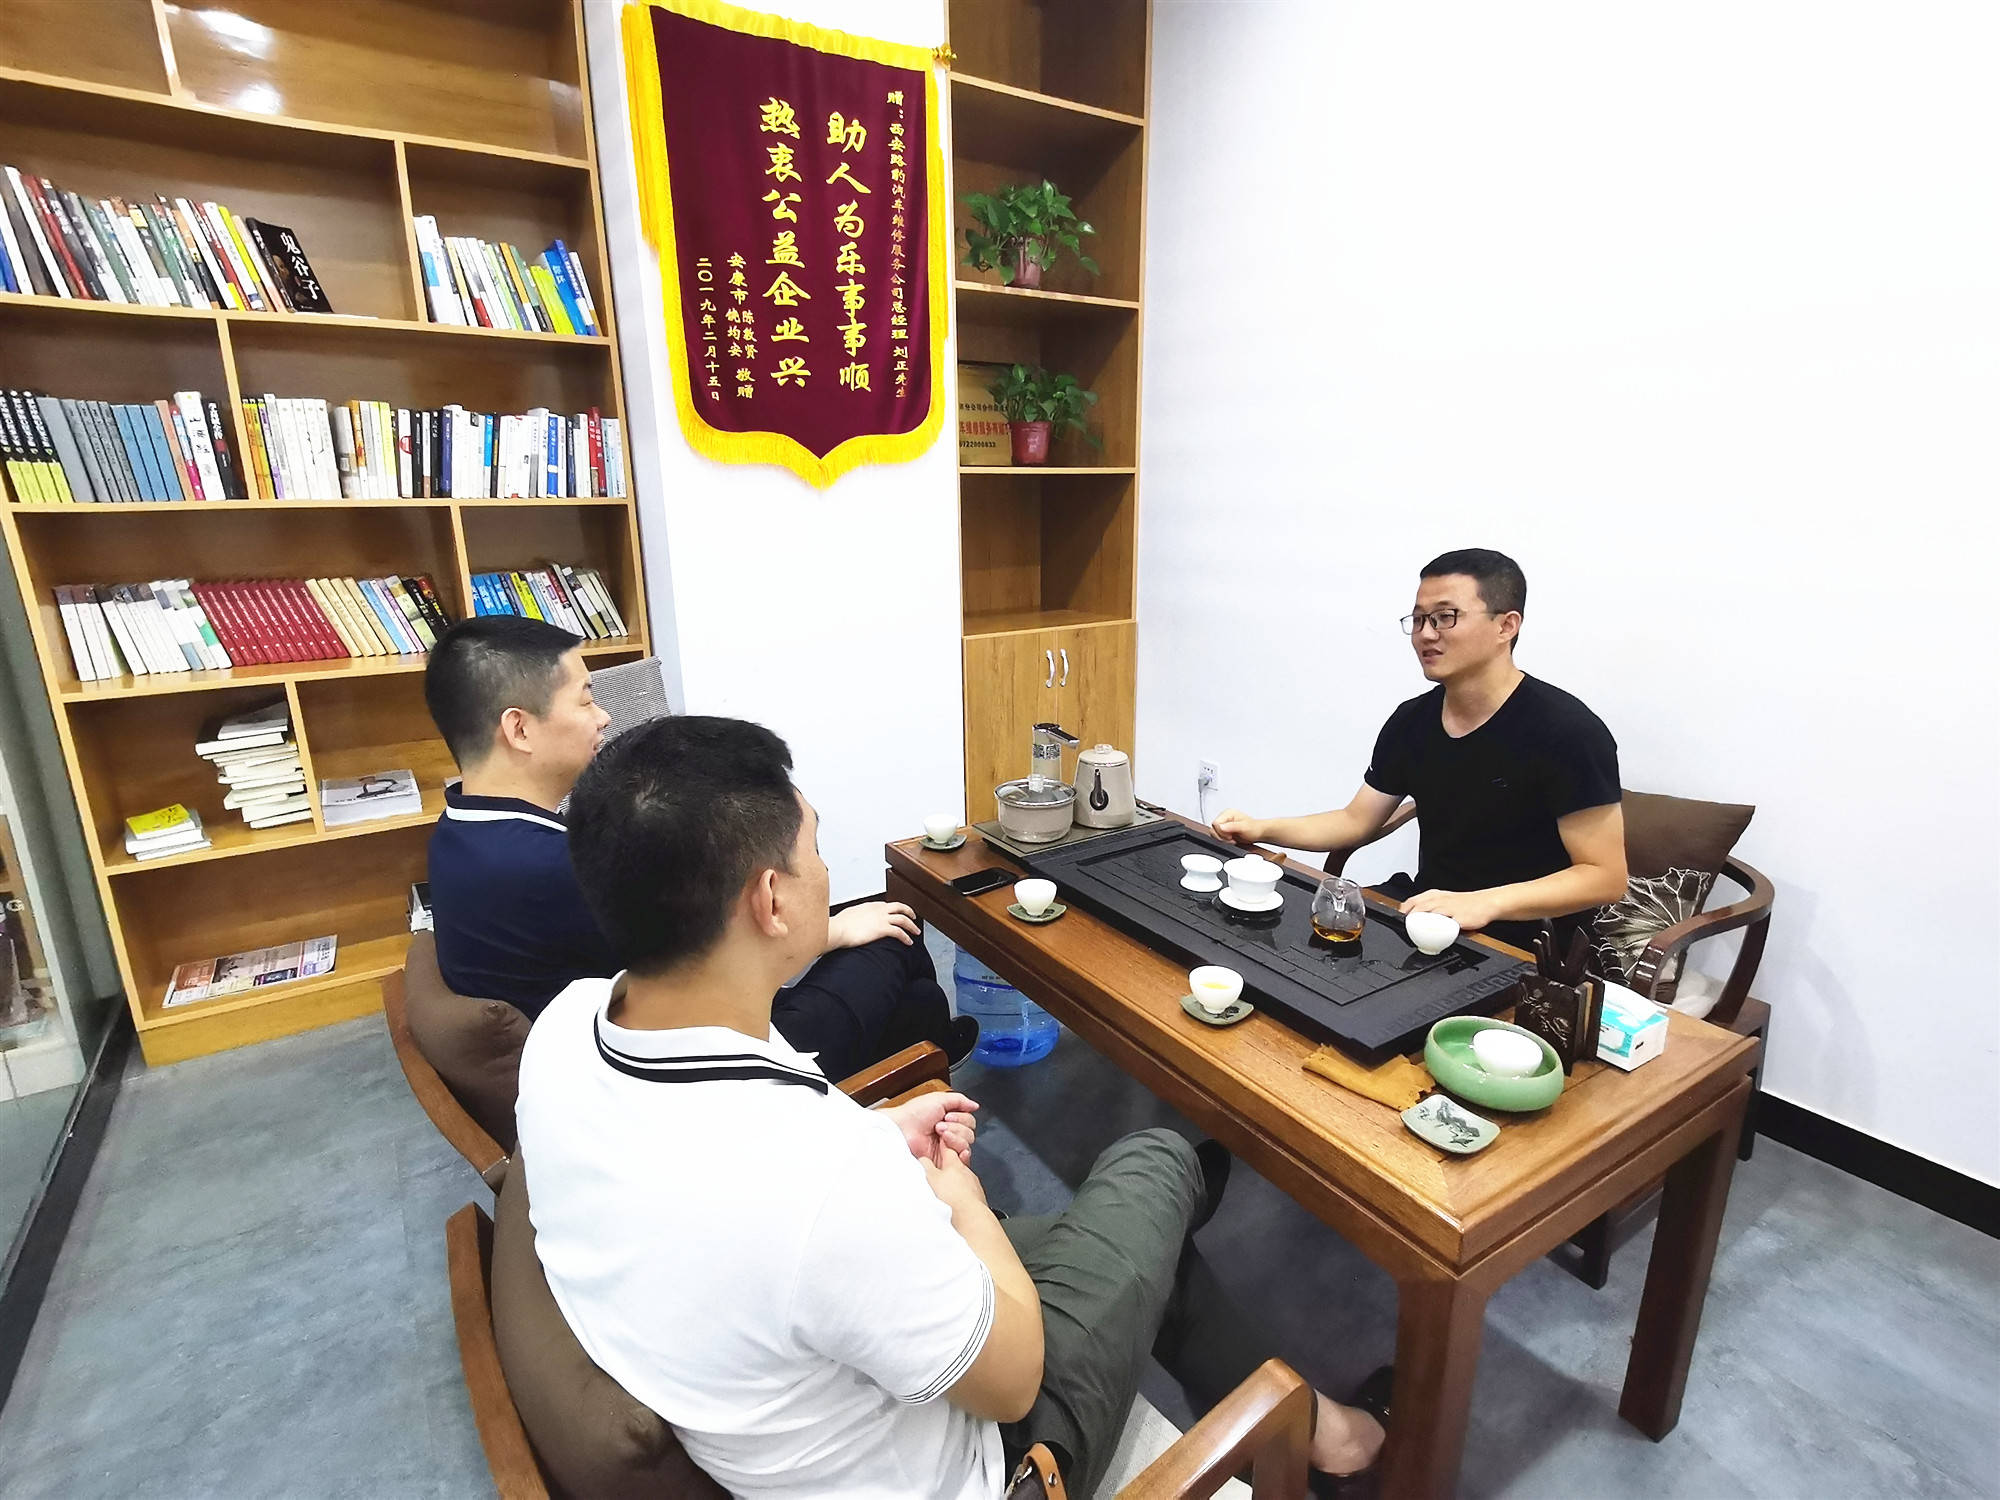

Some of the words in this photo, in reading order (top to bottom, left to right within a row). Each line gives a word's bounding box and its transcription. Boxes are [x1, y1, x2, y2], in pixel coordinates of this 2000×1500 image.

[280, 231, 320, 300] 鬼谷子
[759, 96, 812, 388] 热衷公益企业兴
[825, 111, 872, 393] 助人为乐事事顺
